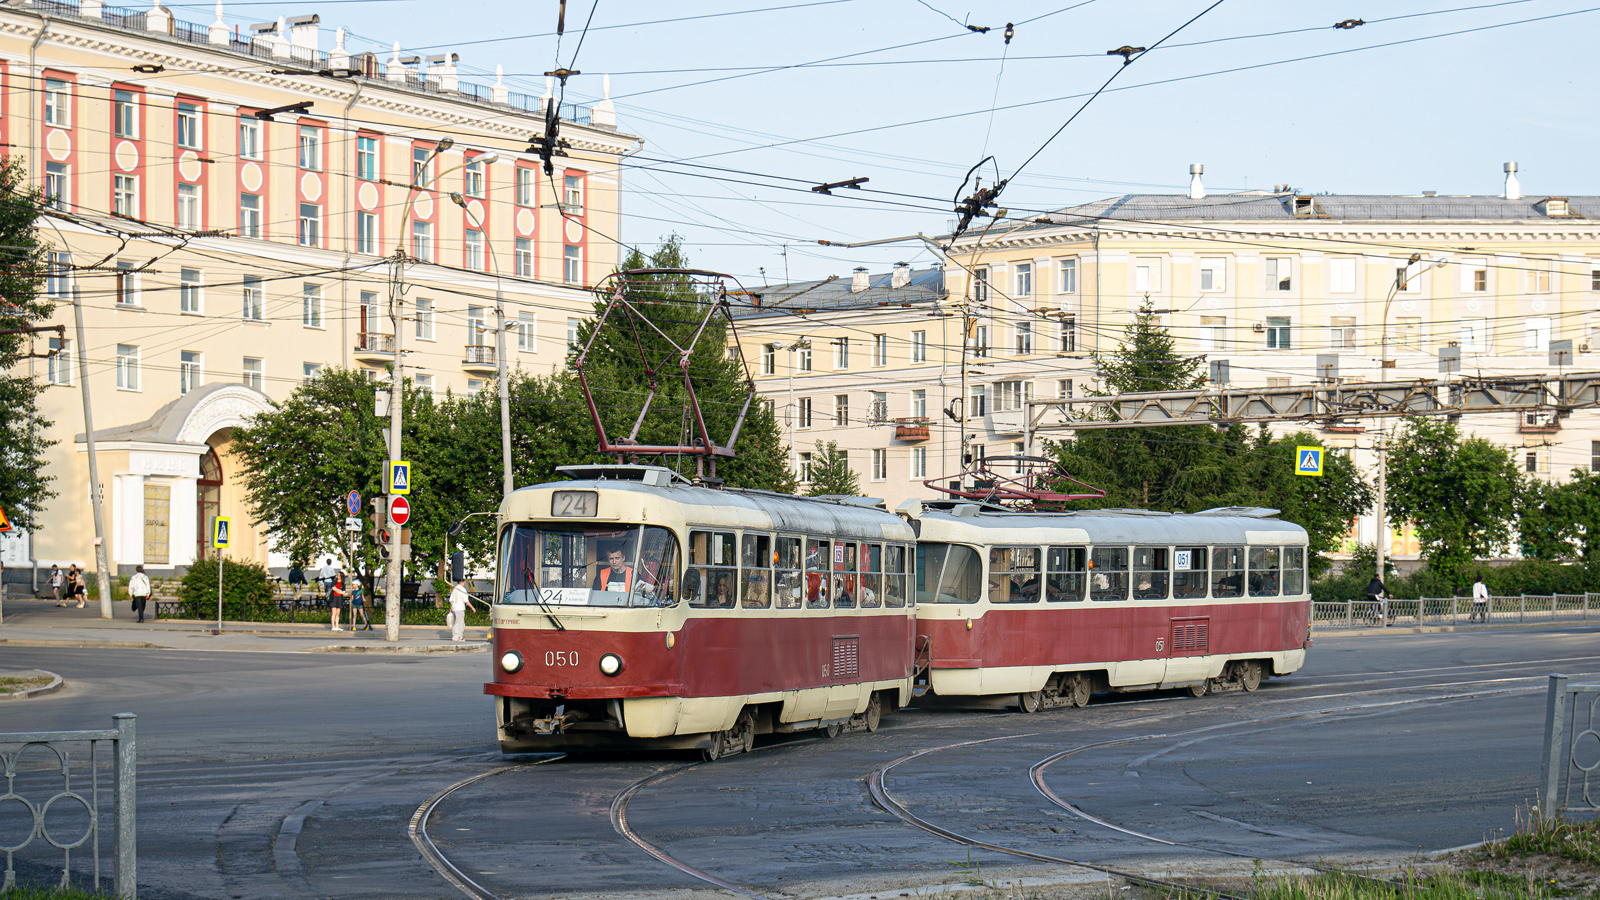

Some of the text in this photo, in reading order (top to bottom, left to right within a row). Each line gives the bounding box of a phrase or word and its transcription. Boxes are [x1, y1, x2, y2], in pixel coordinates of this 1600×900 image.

[561, 493, 587, 515] 24
[1177, 553, 1189, 565] 051
[543, 589, 563, 604] 24
[545, 650, 579, 667] 050
